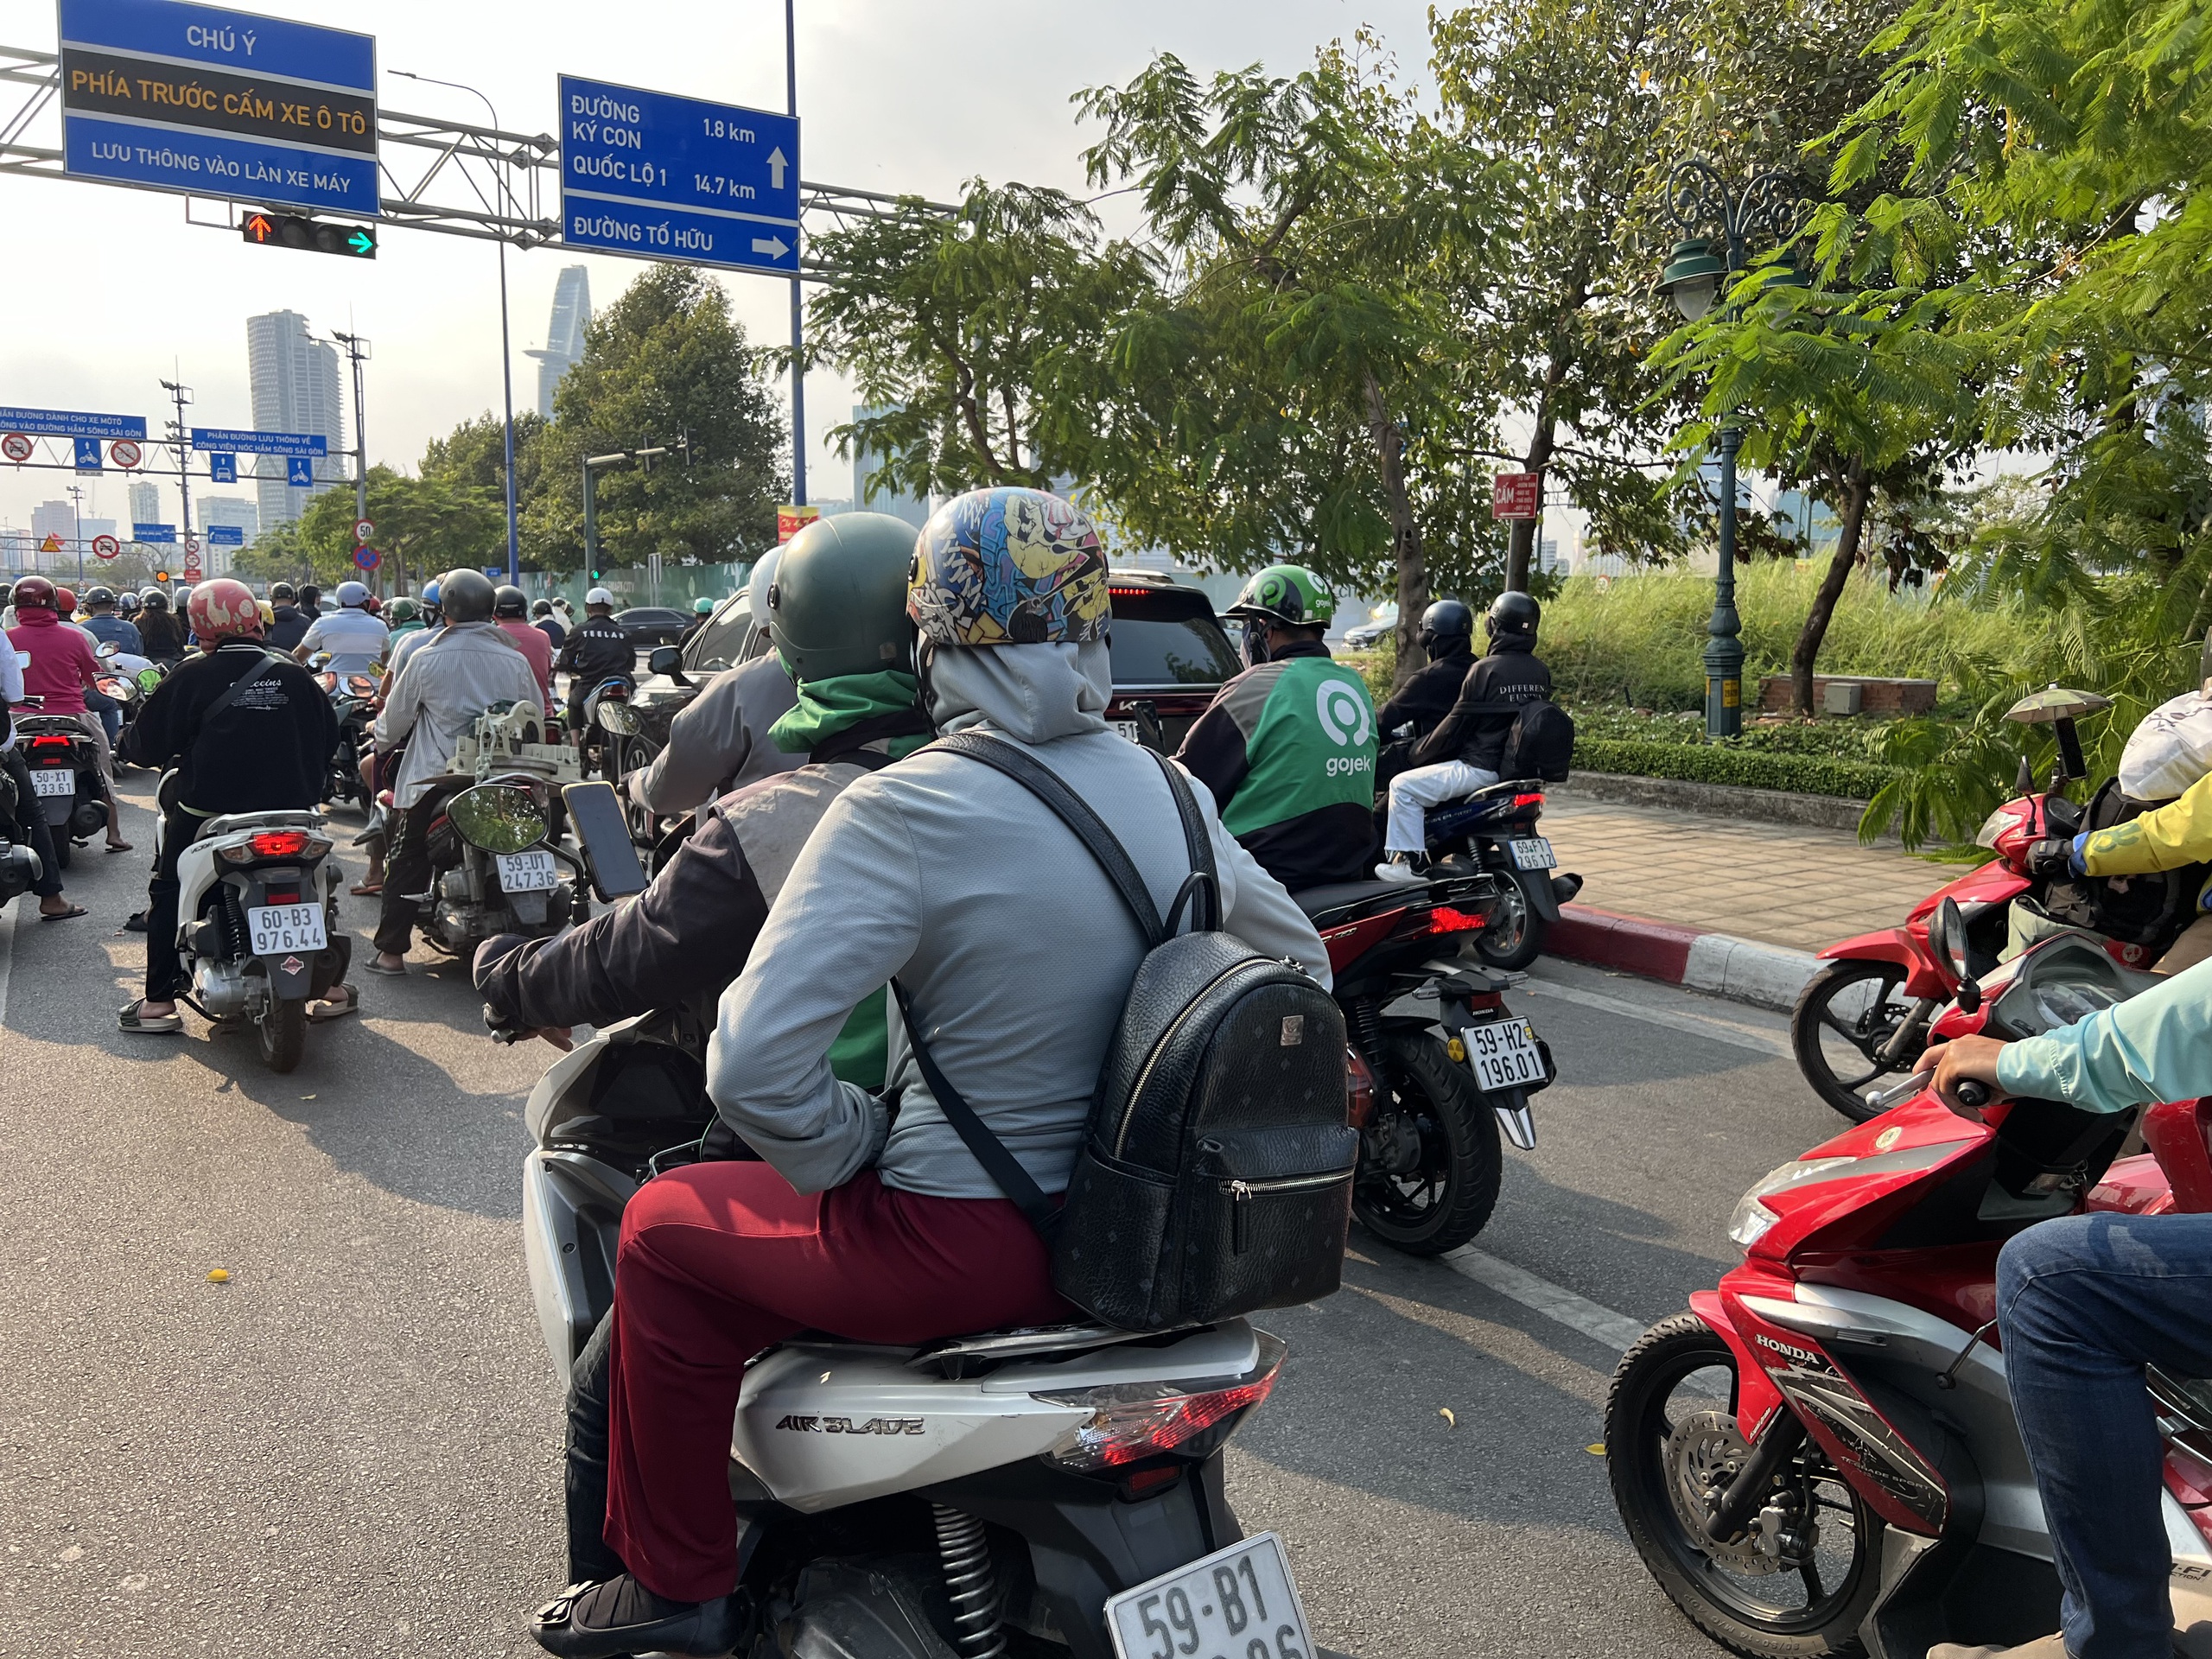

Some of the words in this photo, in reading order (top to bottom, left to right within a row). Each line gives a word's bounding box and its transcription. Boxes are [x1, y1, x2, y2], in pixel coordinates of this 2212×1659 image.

[188, 25, 236, 52] CHÚ
[242, 30, 257, 56] Ý
[72, 69, 131, 99] PHÍA
[137, 79, 218, 111] TRƯỚC
[224, 88, 275, 121] CẤM
[281, 103, 311, 128] XE
[316, 105, 333, 130] Ô
[338, 110, 366, 135] TÔ
[571, 94, 640, 124] ĐƯỜNG
[572, 120, 598, 142] KÝ
[602, 128, 641, 149] CON
[703, 118, 725, 138] 1.8
[729, 123, 755, 143] km
[92, 142, 131, 162] LƯU
[137, 147, 200, 172] THÔNG
[205, 155, 240, 178] VÀO
[245, 160, 282, 184] LÀN
[286, 171, 309, 188] XE
[314, 172, 352, 194] MÁY
[573, 153, 626, 180] QUỐC
[631, 162, 654, 187] LỘ
[659, 168, 667, 187] 1
[694, 174, 725, 195] 14.7
[729, 180, 755, 200] km
[574, 214, 642, 242] ĐƯỜNG
[646, 221, 670, 245] TỐ
[675, 227, 714, 251] HỮU
[16, 410, 44, 420] ĐƯỜNG
[47, 412, 69, 422] DÀNH
[71, 415, 87, 423] CHO
[19, 421, 35, 430] VÀO
[37, 422, 66, 432] ĐƯỜNG
[67, 423, 85, 433] HẦM
[86, 426, 108, 435] SÔNG
[110, 428, 124, 436] SÀI
[124, 429, 142, 437] GÒN
[258, 435, 274, 443] LƯU
[275, 435, 300, 444] THÔNG
[196, 441, 217, 449] CÔNG
[1496, 481, 1515, 505] CẤM
[360, 525, 371, 537] 50
[1499, 683, 1547, 695] DIFFEREN
[1326, 754, 1371, 777] gojek
[35, 782, 71, 795] 133.61
[36, 772, 67, 783] 50-X1
[1517, 854, 1554, 868] 296.12
[504, 871, 554, 889] 247.36
[261, 908, 312, 929] 60-B3
[257, 926, 322, 950] 976.44
[1472, 1007, 1494, 1016] HONDA
[1473, 1022, 1528, 1055] 59-H2
[1480, 1051, 1540, 1087] 196.01
[1755, 1333, 1820, 1365] HONDA
[776, 1414, 822, 1433] AIR
[822, 1417, 925, 1435] BLADE
[1892, 1475, 1929, 1491] SPORT
[1136, 1555, 1268, 1659] 59-B1
